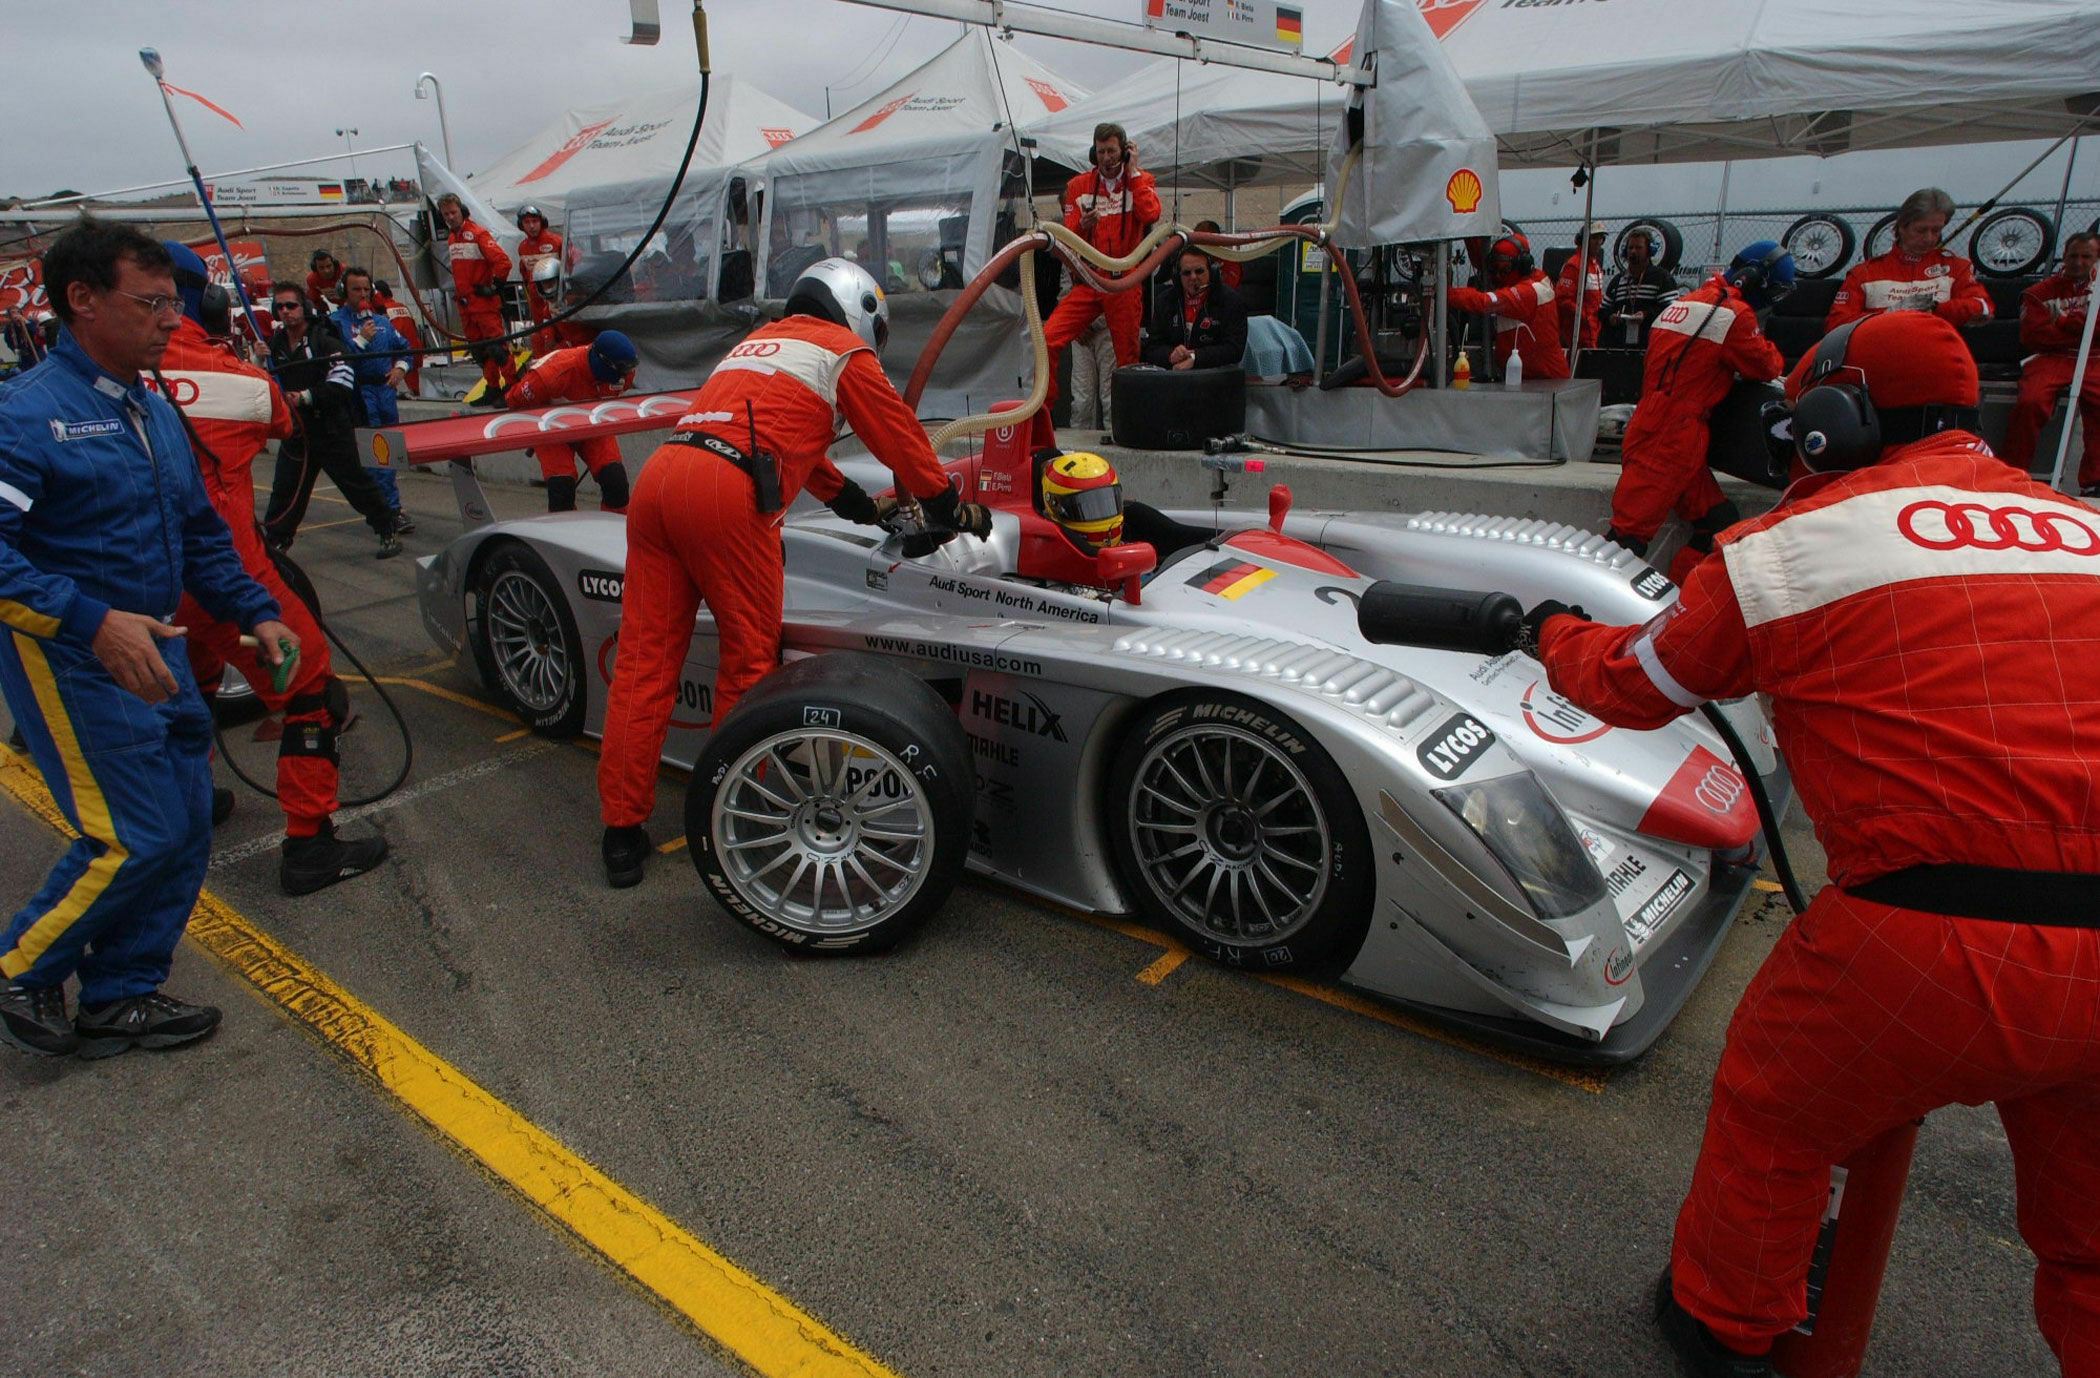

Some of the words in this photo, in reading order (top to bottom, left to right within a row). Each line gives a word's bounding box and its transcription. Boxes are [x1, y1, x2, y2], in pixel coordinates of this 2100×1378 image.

[1165, 3, 1186, 17] Team
[1188, 9, 1209, 23] Joest
[217, 186, 234, 194] Audi
[235, 186, 256, 195] Sport
[236, 194, 256, 202] Joest
[68, 422, 119, 435] MICHELIN
[929, 575, 955, 592] Audi
[957, 583, 991, 601] Sport
[996, 591, 1034, 610] North
[1037, 600, 1099, 625] America
[865, 635, 1042, 675] www.audiusacom
[810, 711, 830, 724] 24
[972, 689, 1068, 743] HELIX
[1192, 703, 1306, 754] MICHELIN
[1426, 719, 1489, 774] LYCOS
[708, 873, 808, 945] MICHELIN
[1641, 872, 1689, 924] MICHELIN
